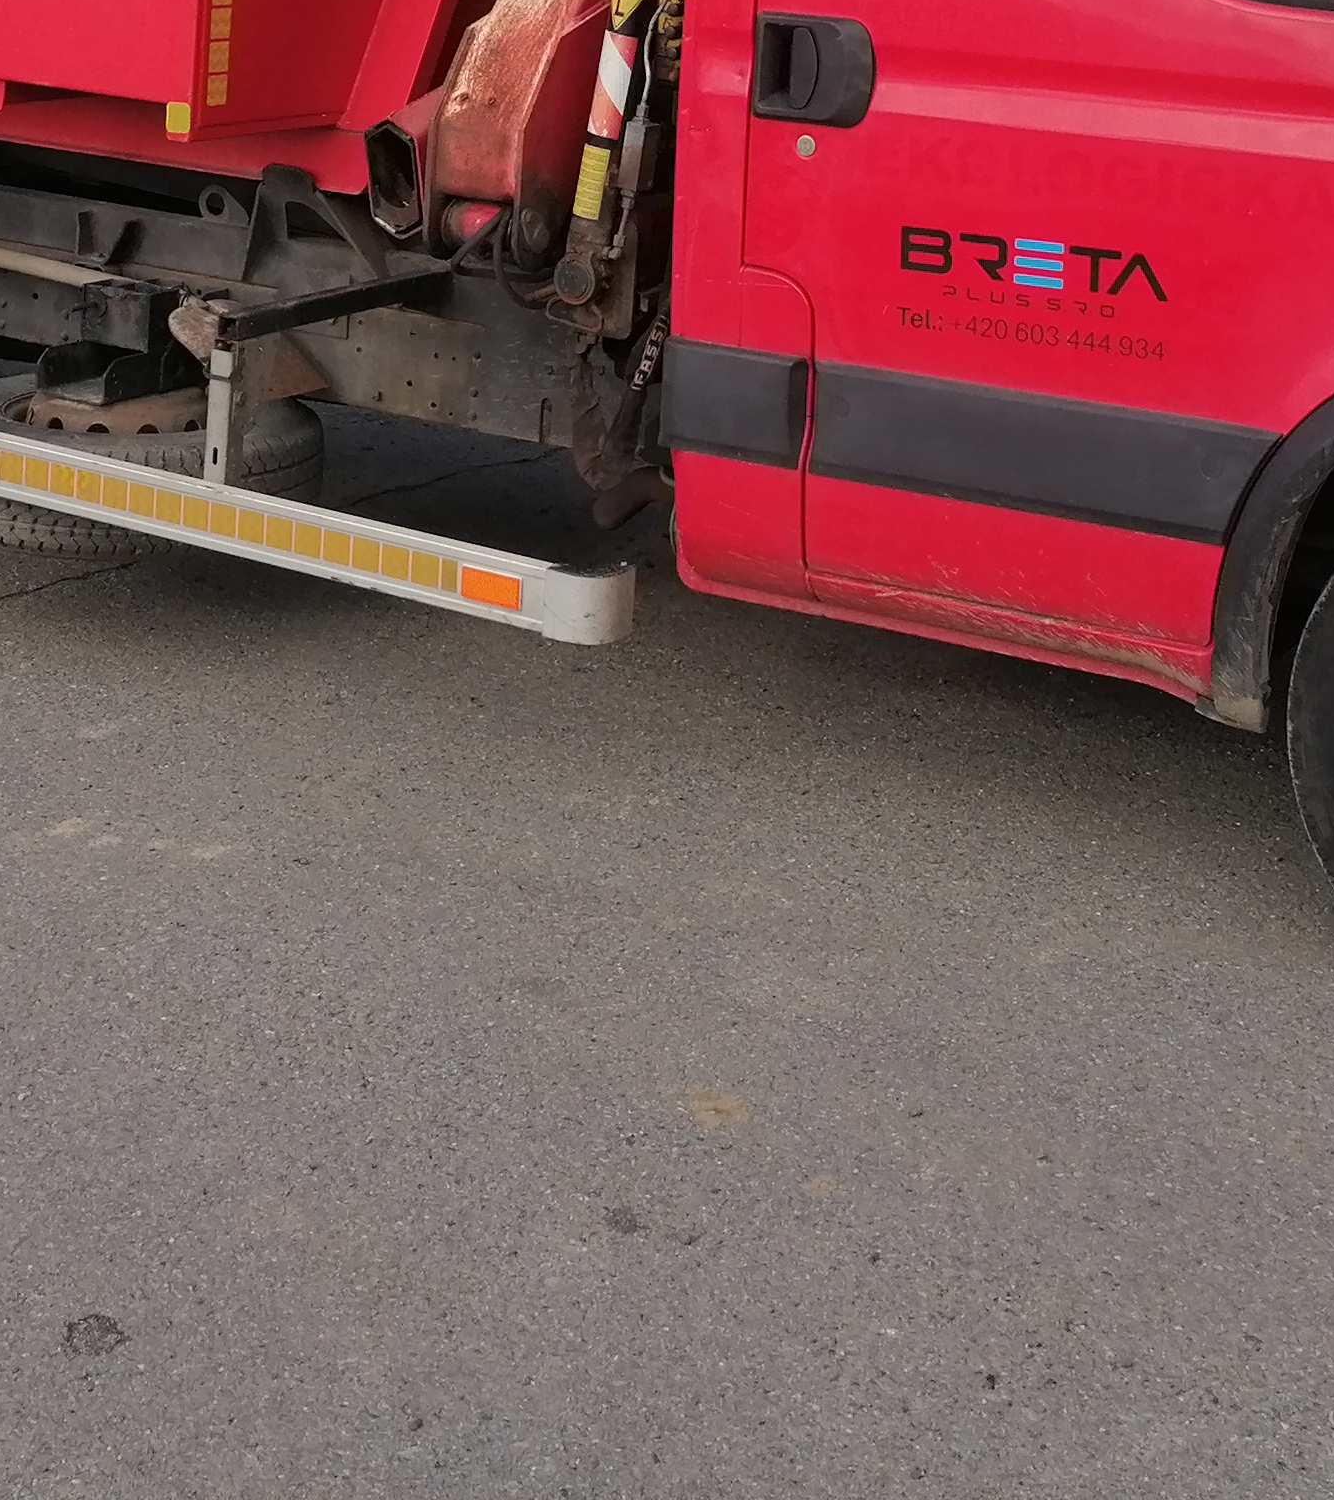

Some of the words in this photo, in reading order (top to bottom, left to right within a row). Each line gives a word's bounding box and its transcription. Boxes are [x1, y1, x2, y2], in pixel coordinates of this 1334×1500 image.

[900, 225, 1168, 302] BRETA
[942, 285, 1031, 308] PLUS
[896, 305, 944, 332] Tel.:
[951, 315, 1009, 340] +420
[1014, 321, 1060, 348] 603
[1066, 329, 1112, 354] 444
[1118, 335, 1165, 361] 934
